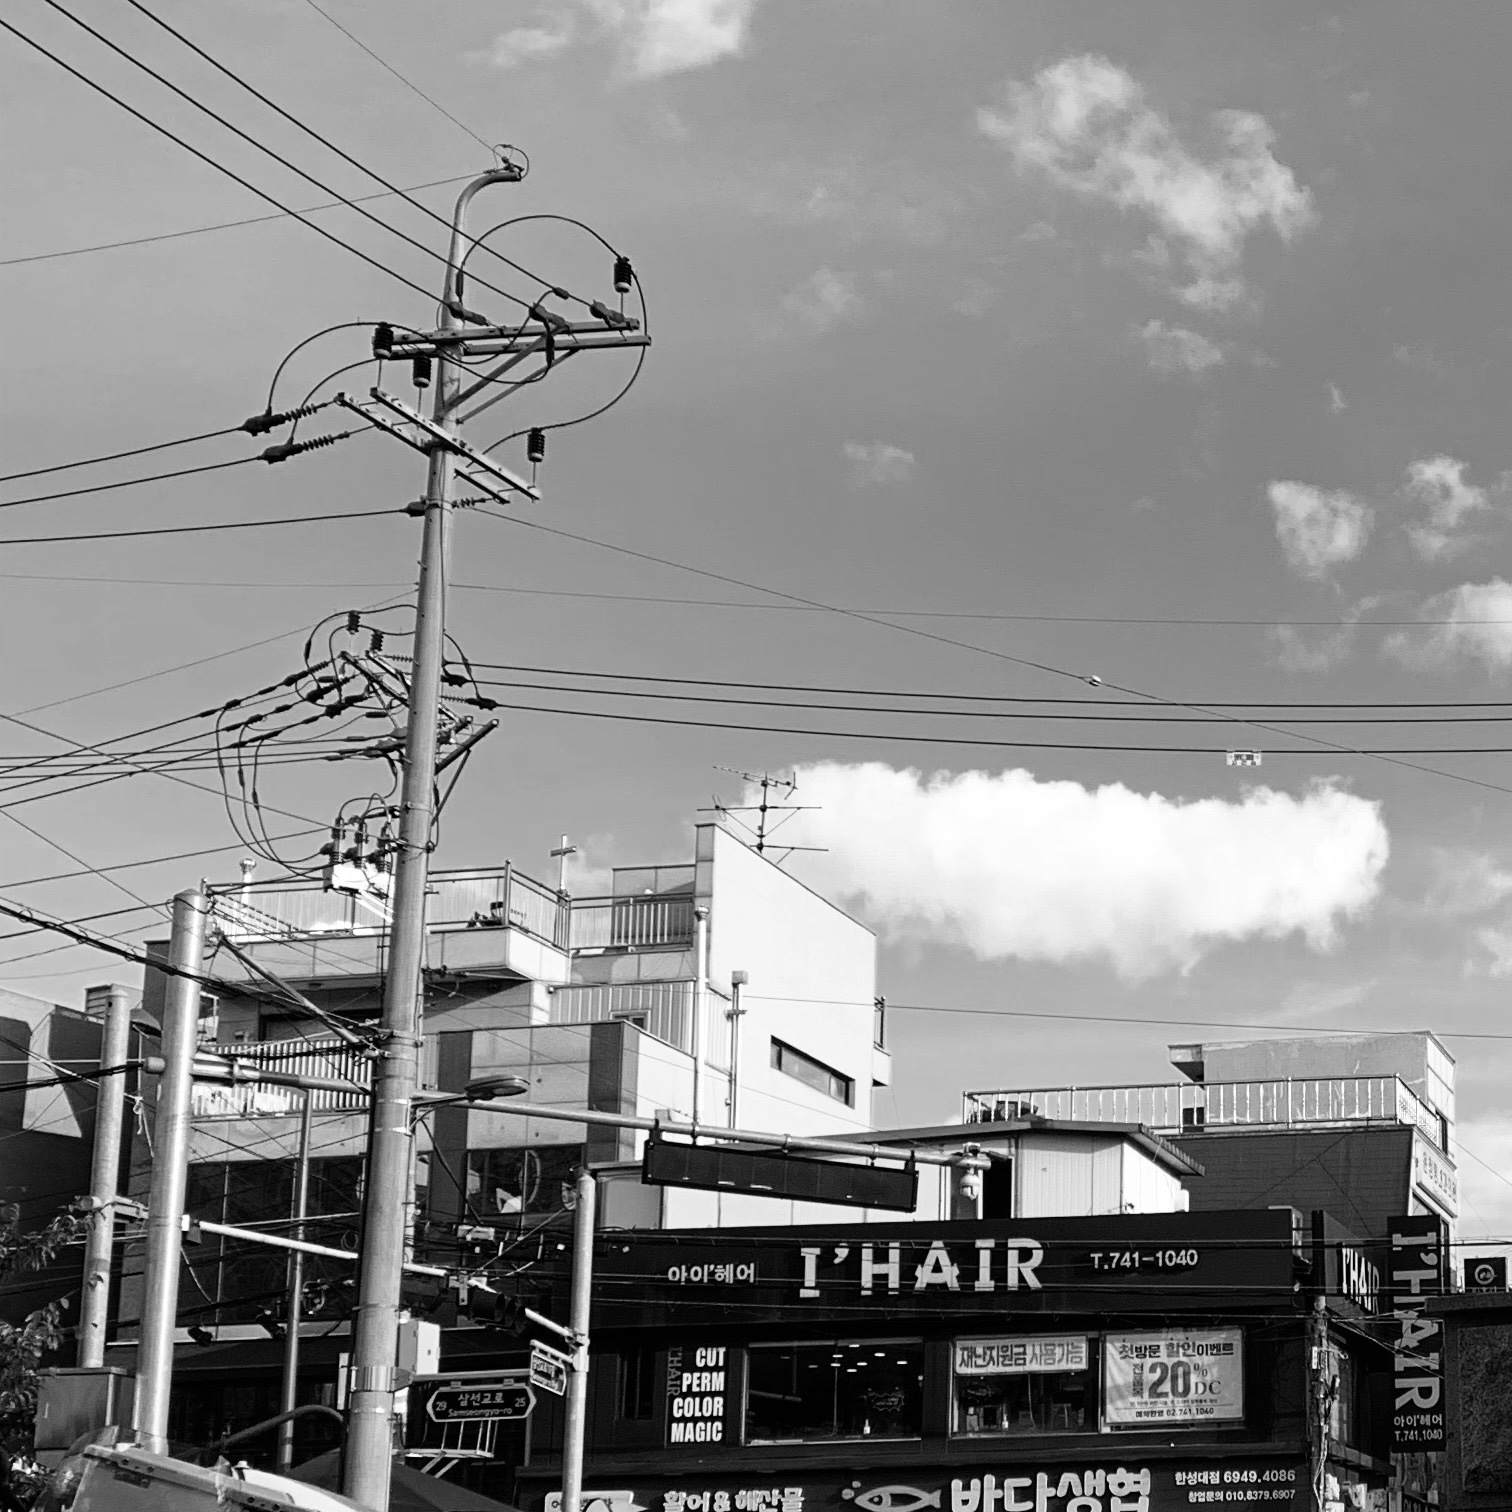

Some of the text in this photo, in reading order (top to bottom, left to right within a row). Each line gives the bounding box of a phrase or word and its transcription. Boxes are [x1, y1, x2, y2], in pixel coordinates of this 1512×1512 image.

[799, 1238, 1045, 1297] I'HAIR
[1090, 1249, 1199, 1270] T.741-1040
[667, 1262, 756, 1285] 아이'헤어
[695, 1346, 727, 1368] CUT
[958, 1342, 1085, 1368] 재난지원금 사용가능
[1118, 1338, 1234, 1359] 첫방문 할인이벤트
[681, 1371, 726, 1393] PERM
[435, 1401, 447, 1411] 29
[458, 1392, 505, 1407] 삼선교로
[515, 1397, 526, 1407] 25
[672, 1396, 724, 1418] COLOR
[670, 1421, 723, 1443] MAGIC
[1175, 1469, 1296, 1485] 한성대점 6949.4086
[1225, 1489, 1296, 1502] 010.8379.6907
